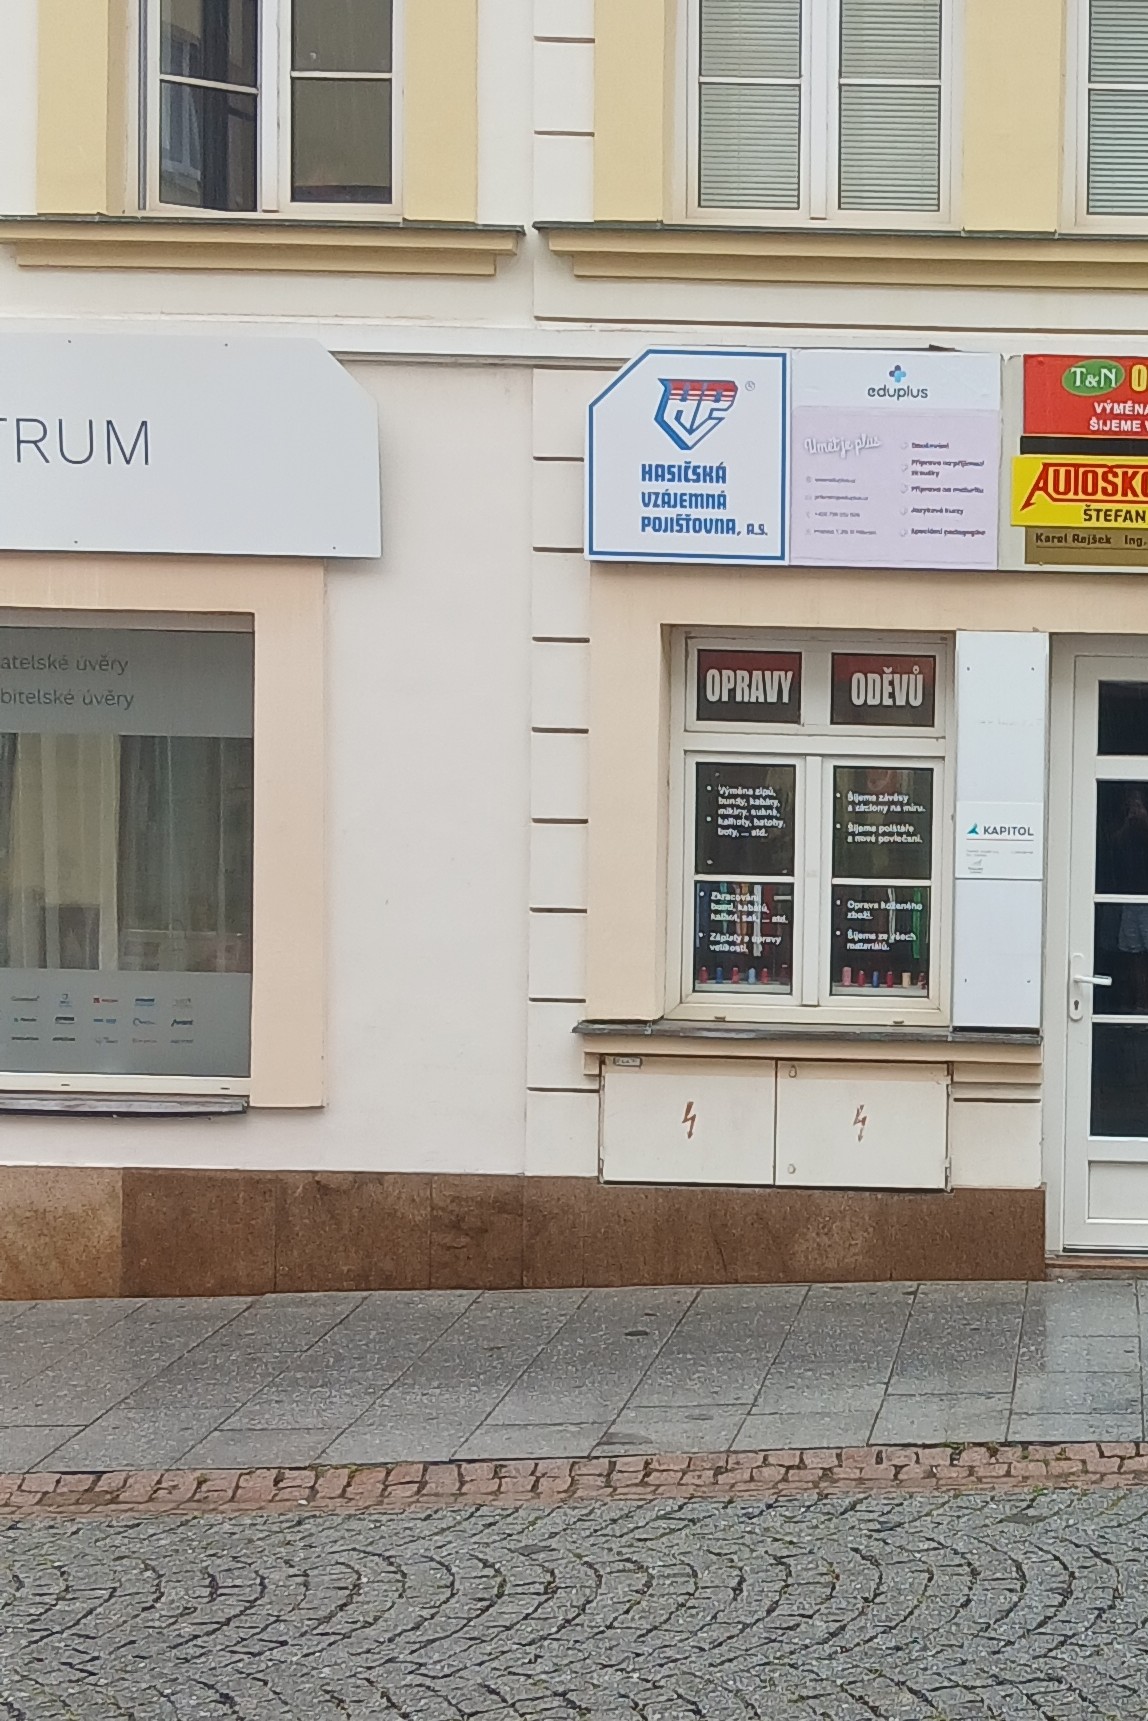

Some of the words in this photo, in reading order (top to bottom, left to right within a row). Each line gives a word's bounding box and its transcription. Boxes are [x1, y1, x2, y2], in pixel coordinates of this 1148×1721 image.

[1070, 366, 1117, 389] T&N
[867, 384, 929, 401] eduplus
[1089, 416, 1141, 431] ŠIJEME
[0, 417, 149, 465] RUM
[641, 461, 727, 484] HASIČSKÁ
[641, 488, 727, 510] VZÁJEMNÁ
[1083, 504, 1146, 523] ŠTEFAN
[641, 514, 742, 536] POJIŠŤOVNA,
[1035, 532, 1068, 544] Karel
[1072, 532, 1112, 546] Rejšek
[1124, 534, 1147, 547] Ing.
[76, 655, 129, 676] úvěry
[706, 668, 793, 703] OPRAVY
[851, 665, 923, 707] ODĚVŮ
[82, 689, 134, 711] úvěry
[983, 825, 1034, 836] KAPITOL
